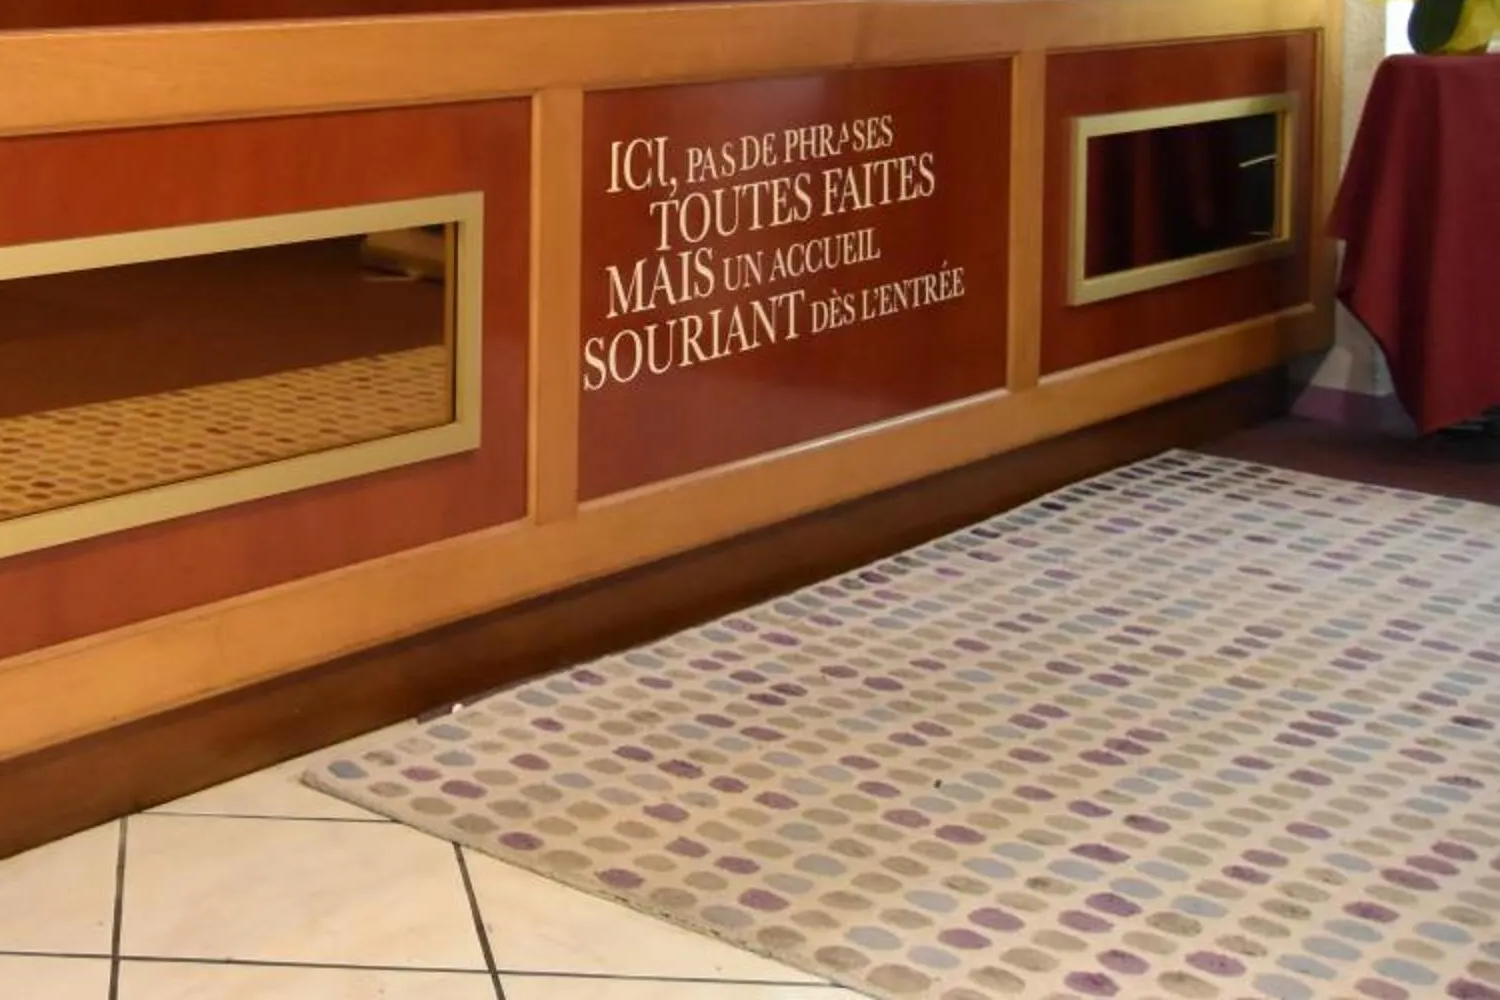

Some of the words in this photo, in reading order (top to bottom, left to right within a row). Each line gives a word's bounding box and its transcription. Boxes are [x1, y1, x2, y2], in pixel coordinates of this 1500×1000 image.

[605, 136, 678, 199] ICI,
[686, 146, 736, 184] PAS
[739, 132, 778, 172] DE
[784, 114, 894, 164] PHRASES
[650, 172, 813, 251] TOUTES
[821, 152, 936, 217] FAITES
[605, 247, 716, 319] MAIS
[722, 251, 765, 292] UN
[768, 227, 882, 282] ACCUEIL
[583, 290, 805, 391] SOURIANT
[811, 289, 856, 335] DÈS
[861, 259, 966, 322] L'ENTRÉE
